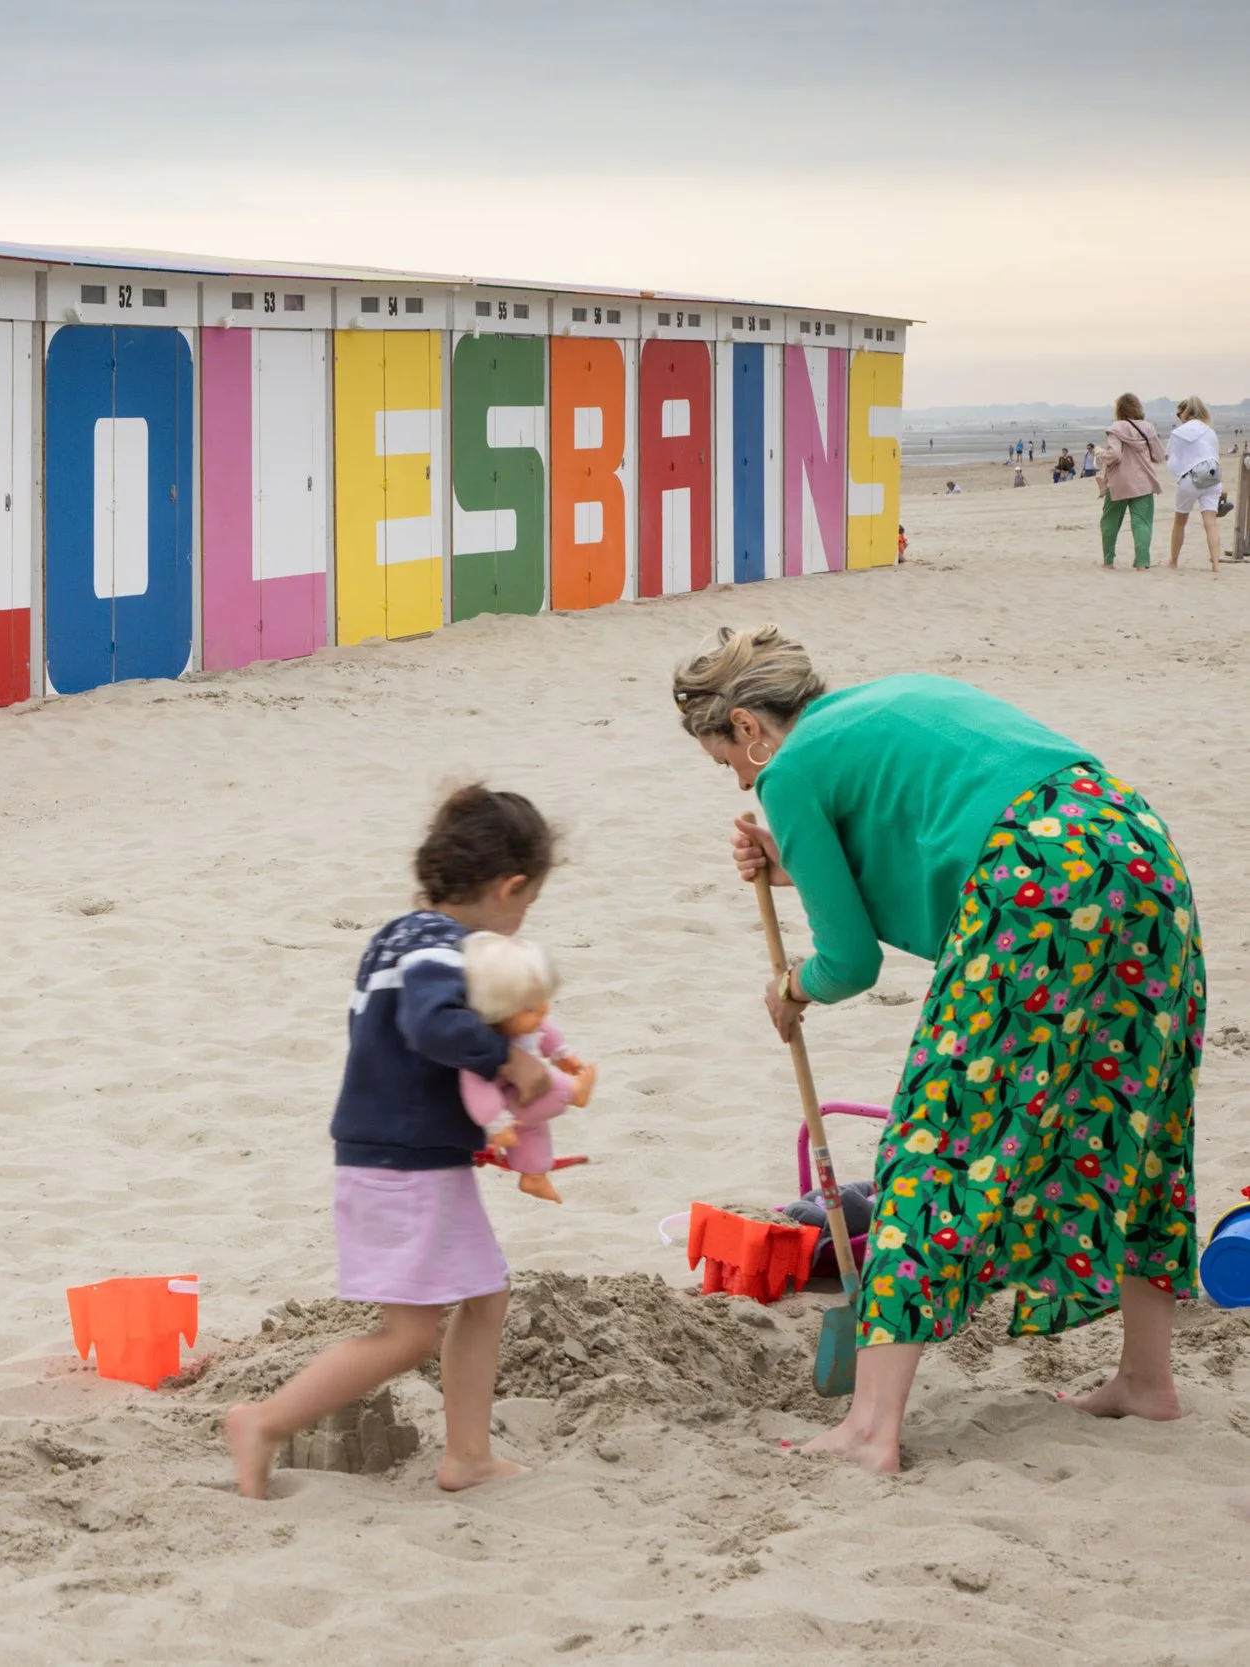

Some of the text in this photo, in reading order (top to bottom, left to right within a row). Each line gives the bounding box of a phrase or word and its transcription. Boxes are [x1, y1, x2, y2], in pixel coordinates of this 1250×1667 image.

[119, 284, 133, 309] 52
[264, 291, 276, 314] 53
[388, 296, 399, 317] 54
[498, 301, 507, 320] 55
